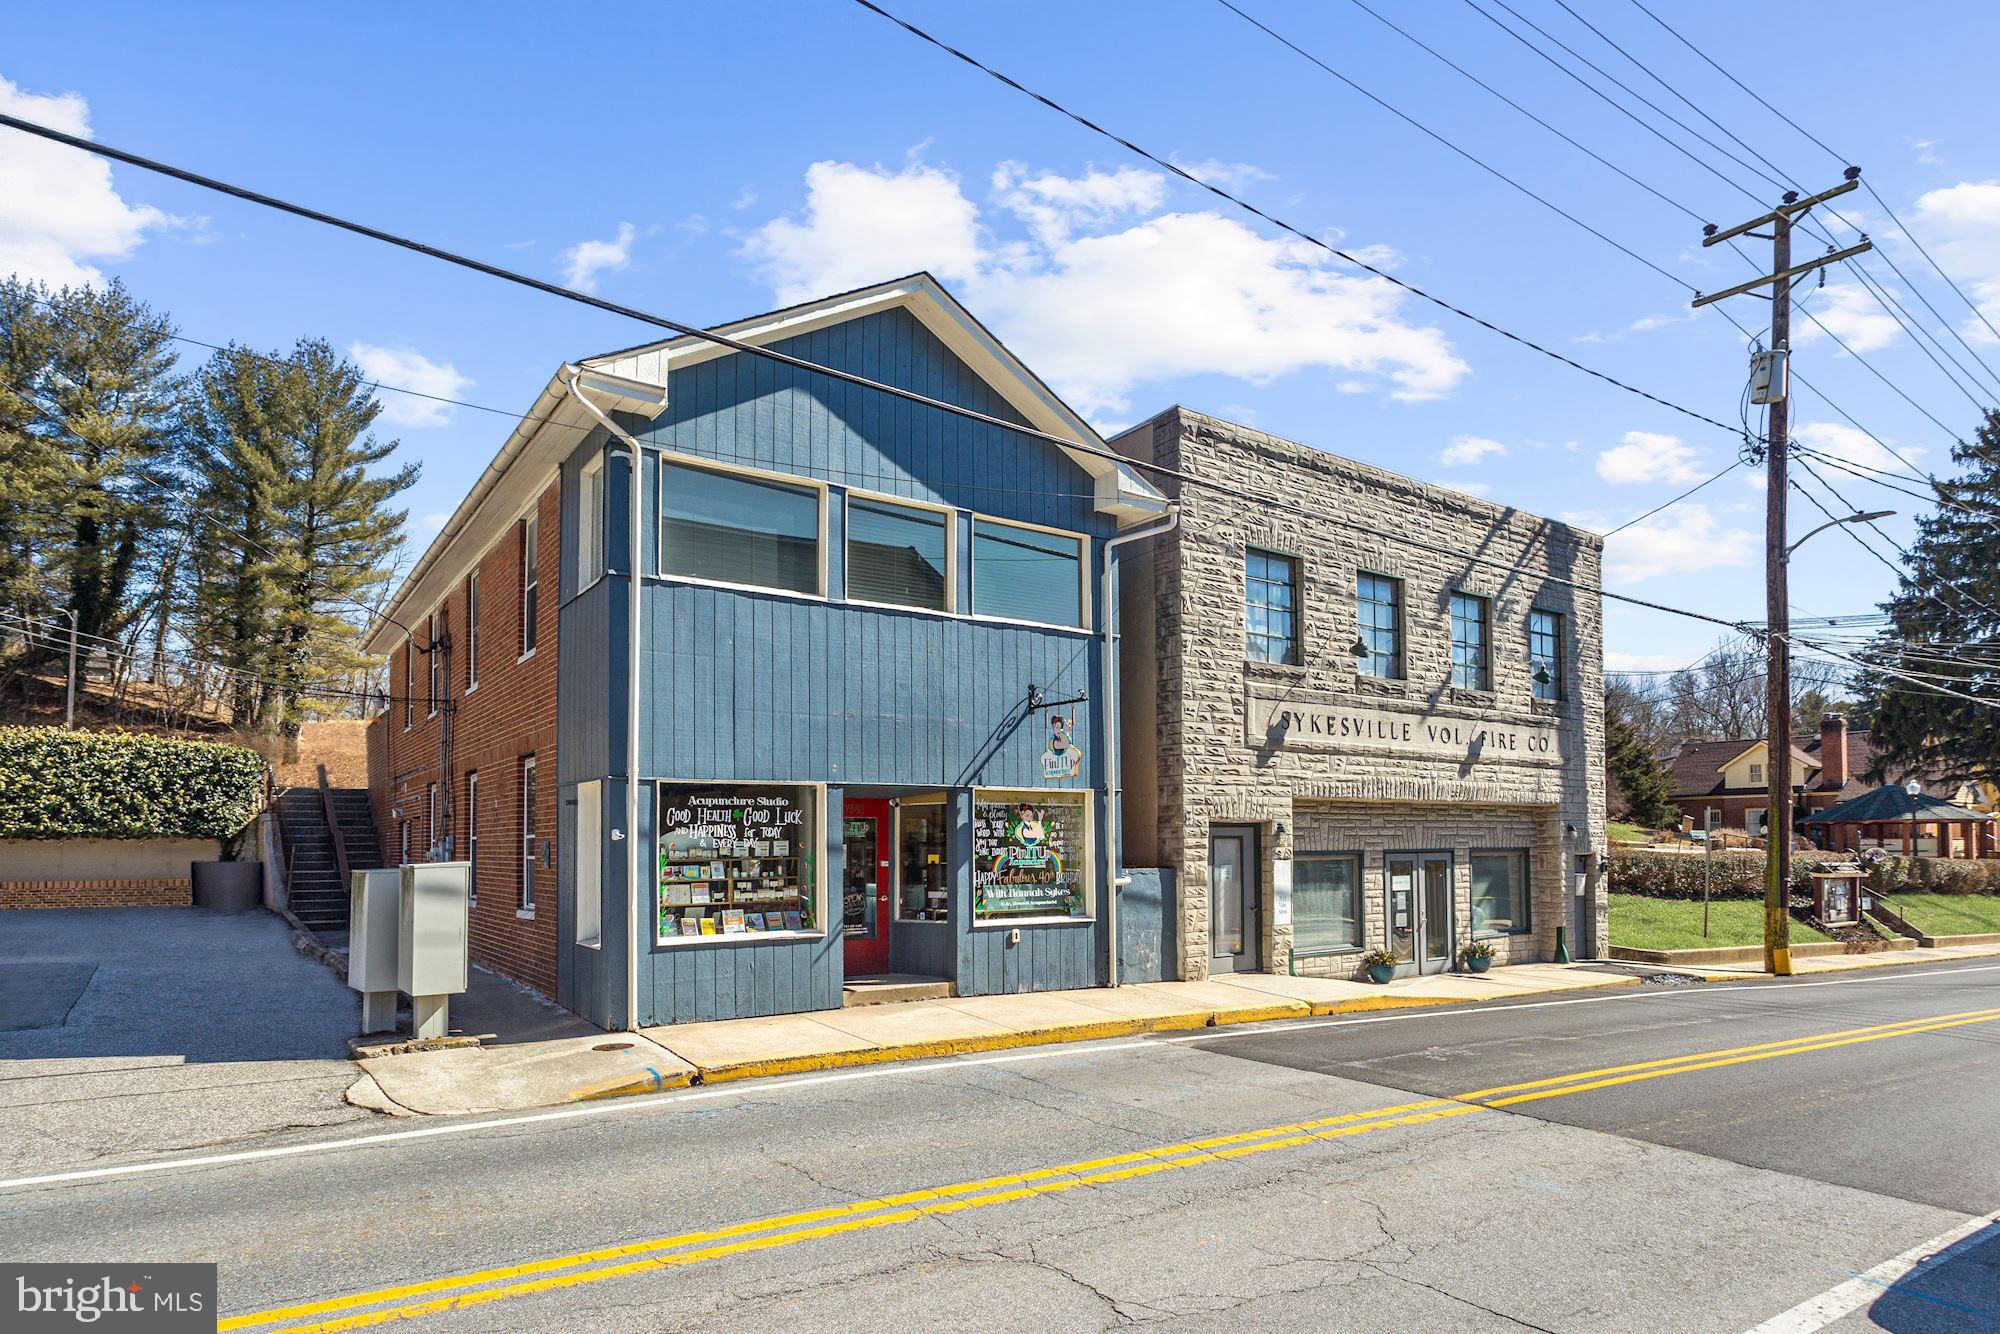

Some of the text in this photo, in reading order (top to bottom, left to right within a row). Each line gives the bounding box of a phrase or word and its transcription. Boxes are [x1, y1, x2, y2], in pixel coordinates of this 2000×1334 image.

[1281, 710, 1555, 754] SYKESVILLE VOL. FIRE CO.
[687, 795, 789, 807] Acupuncture Studio
[666, 806, 803, 827] GOOD HEALTH GOOD LUCK
[674, 823, 782, 840] AND HAPPINESS for TODAY
[699, 837, 759, 849] & EVERY DAY
[1009, 858, 1046, 867] Acupuncture
[975, 870, 998, 888] HAPPY
[996, 868, 1038, 886] Fabulous
[986, 886, 1071, 900] With Hannah Sykes
